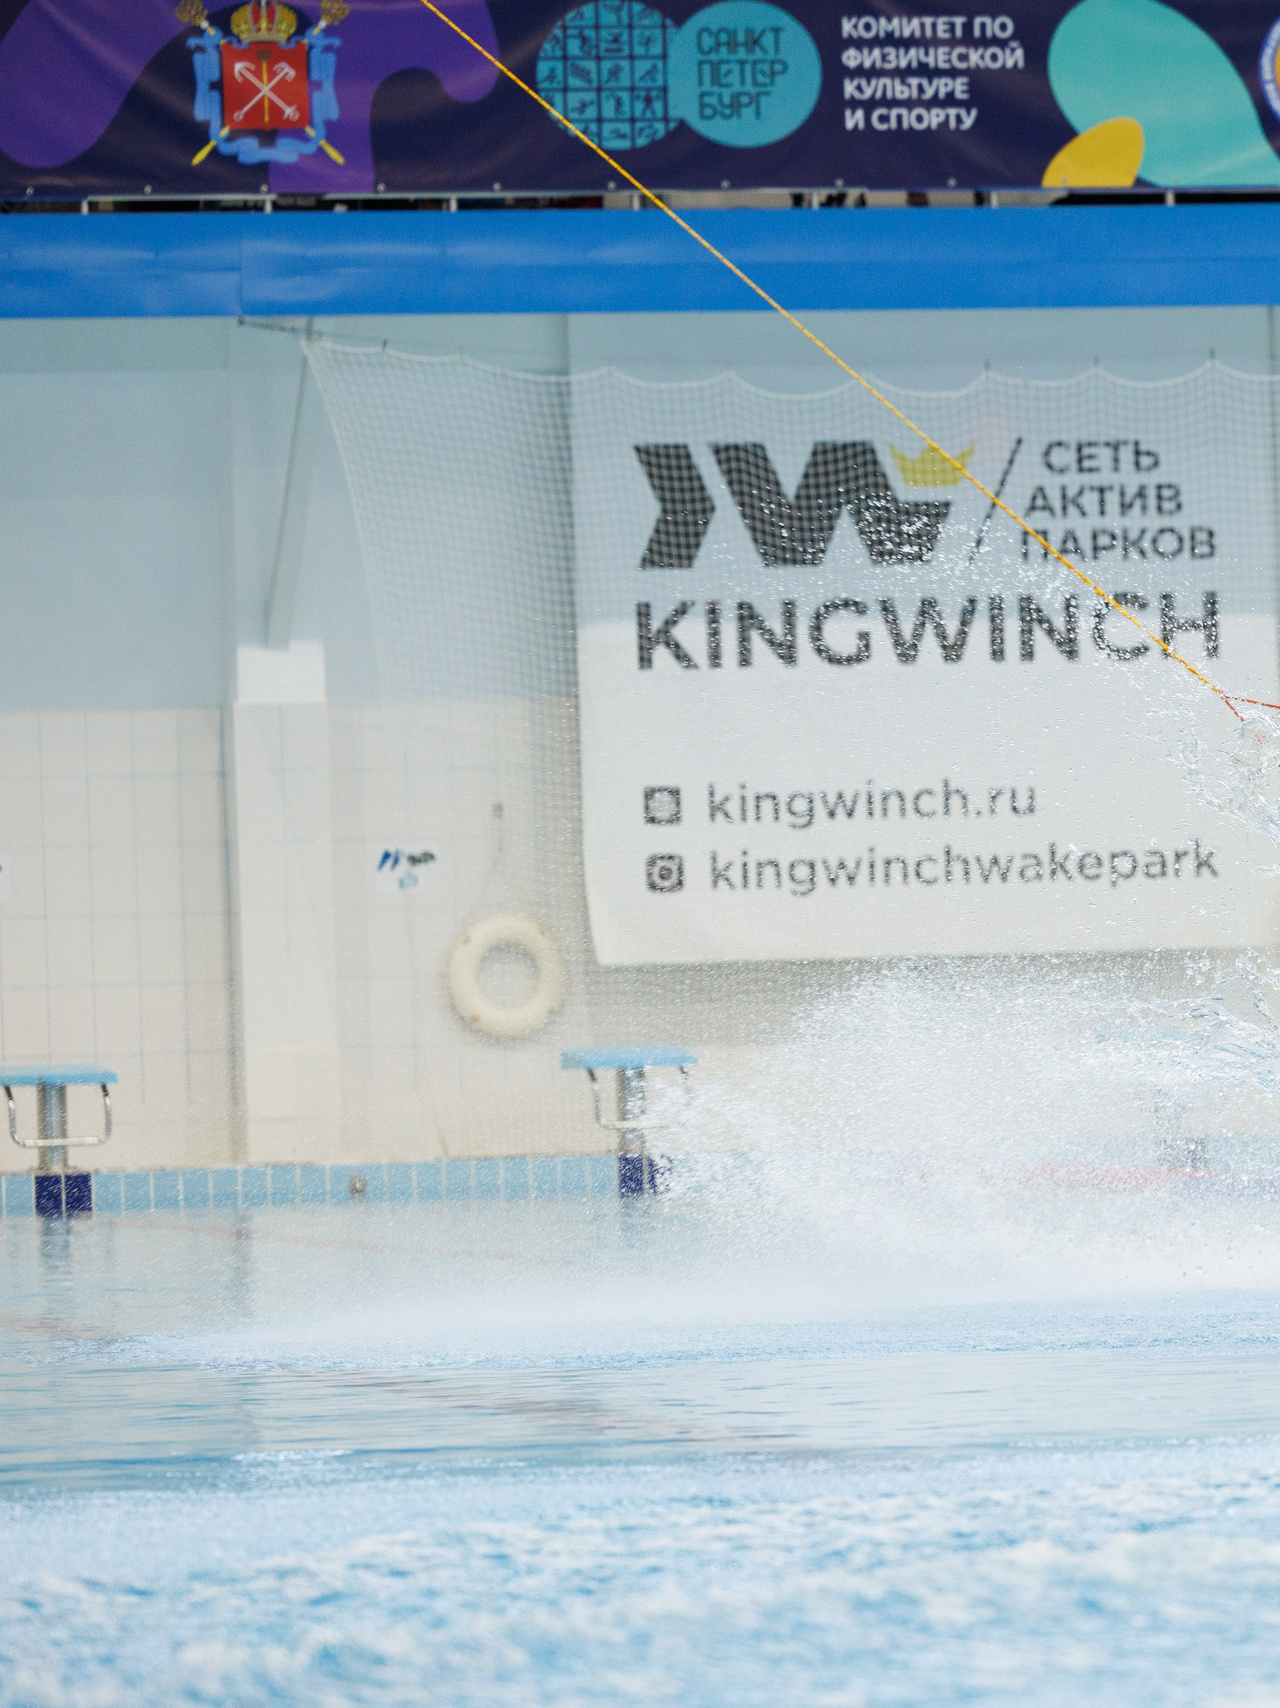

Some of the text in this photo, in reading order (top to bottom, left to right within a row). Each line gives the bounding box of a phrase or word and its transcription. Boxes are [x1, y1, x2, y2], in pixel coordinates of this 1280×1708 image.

[697, 27, 784, 55] САНКТ
[842, 15, 1015, 39] КОМИТЕТ ПО
[841, 41, 1025, 69] ФИЗИЧЕСКОЙ
[698, 60, 788, 87] ПЕТЕР
[843, 77, 970, 100] КУЛЬТУРЕ
[699, 91, 771, 120] БУРГ
[844, 107, 978, 131] И СПОРТУ
[1043, 438, 1159, 474] СЕТЬ
[1025, 483, 1183, 518] АКТИВ
[1020, 526, 1216, 561] ПАРКОВ
[636, 591, 1219, 670] KINGWINCH
[707, 779, 1036, 829] kingwinch.ru
[709, 838, 1219, 896] kingwinchwakepark
